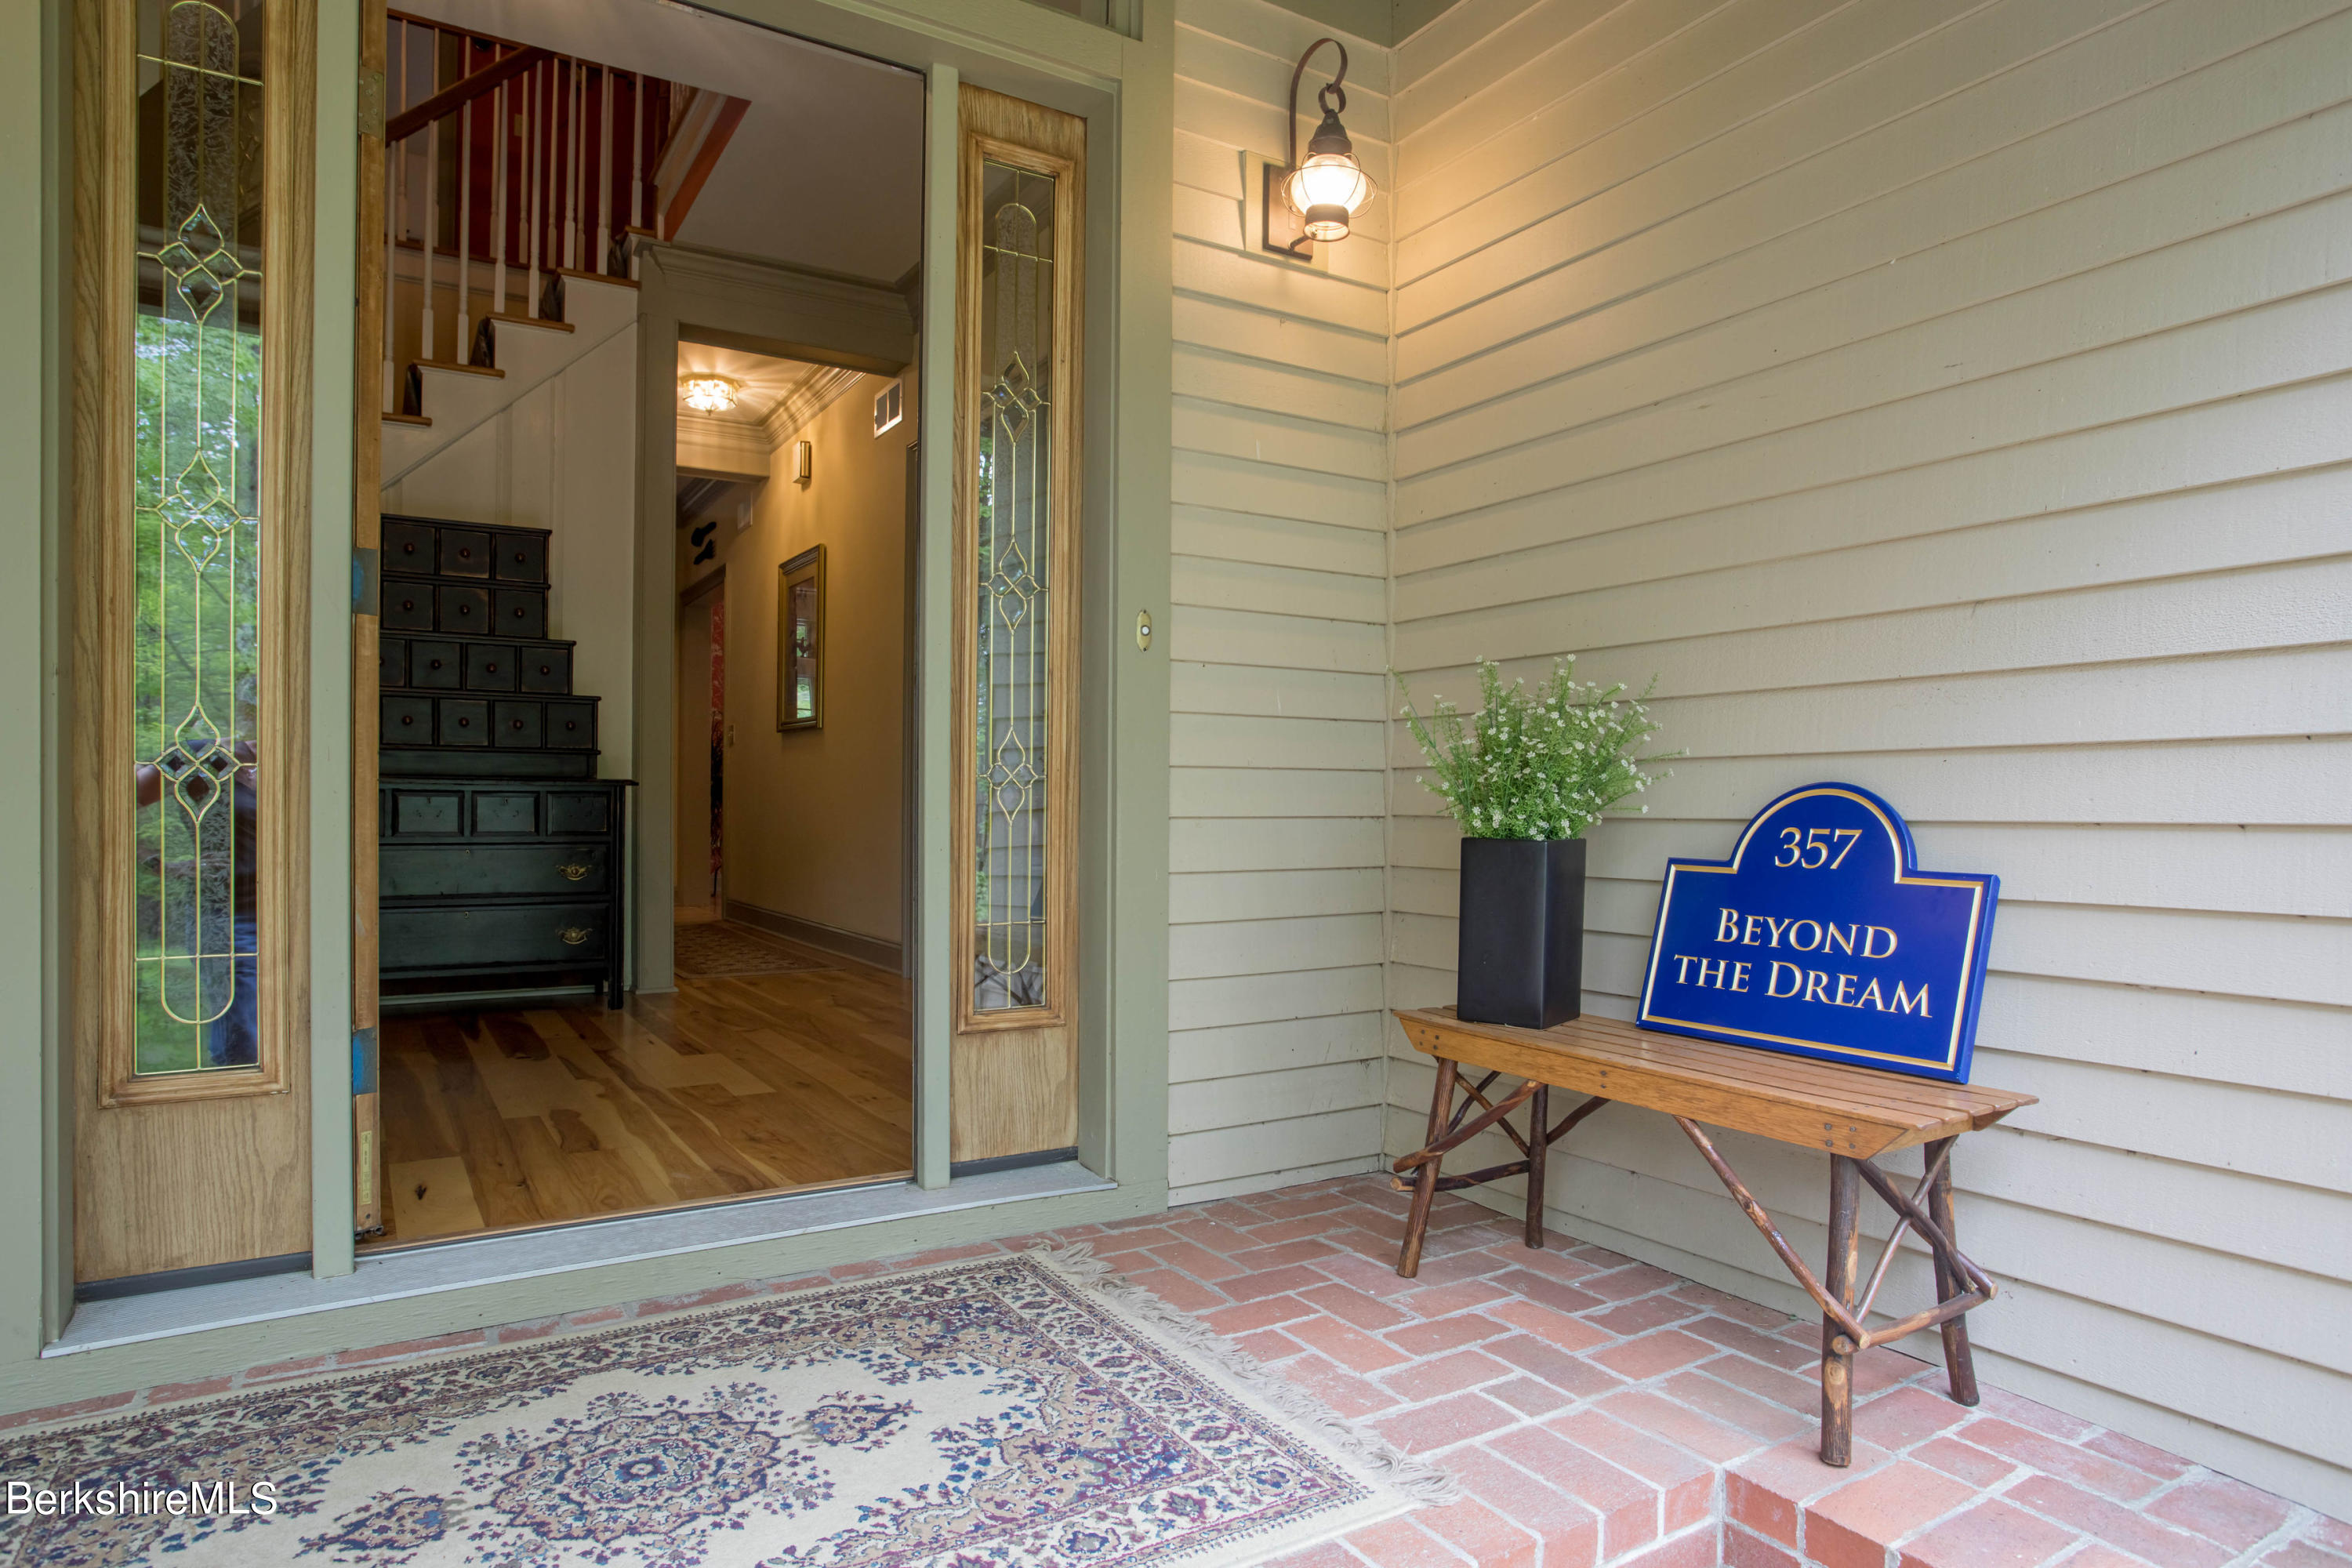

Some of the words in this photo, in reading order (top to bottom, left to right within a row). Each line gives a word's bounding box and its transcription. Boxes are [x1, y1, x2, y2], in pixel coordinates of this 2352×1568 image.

[1774, 827, 1863, 869] 357
[1714, 908, 1898, 959] BEYOND
[1674, 954, 1752, 993] THE
[1765, 960, 1933, 1018] DREAM
